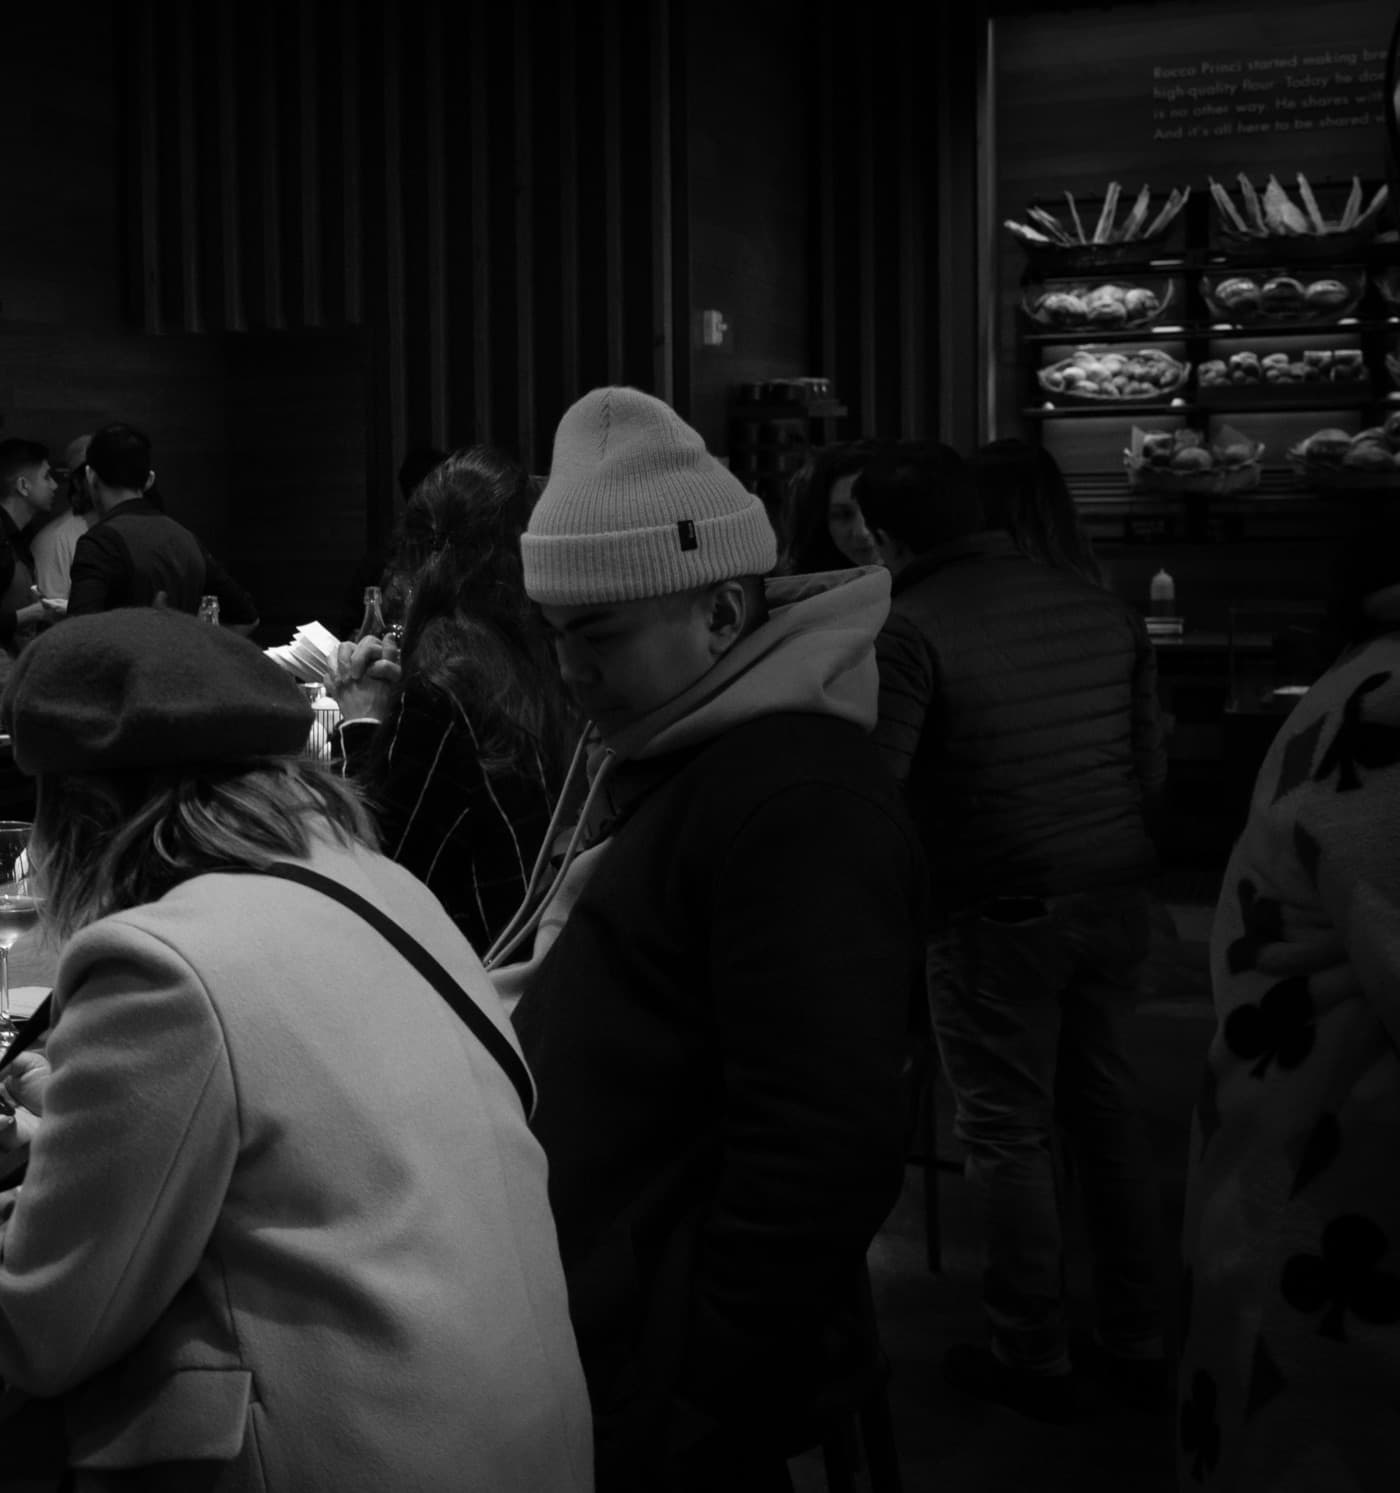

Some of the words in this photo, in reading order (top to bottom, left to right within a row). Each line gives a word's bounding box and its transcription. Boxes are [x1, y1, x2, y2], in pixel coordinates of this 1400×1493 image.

[1153, 66, 1197, 79] Rocco
[1201, 61, 1241, 73] Princi
[1248, 55, 1297, 71] started
[1303, 50, 1357, 65] making
[1362, 48, 1387, 62] bre
[1285, 74, 1329, 88] Today
[1335, 71, 1353, 83] he
[1358, 69, 1385, 83] doe
[1169, 107, 1188, 119] no
[1193, 103, 1229, 117] other
[1275, 95, 1296, 109] He
[1301, 93, 1349, 107] shares
[1153, 125, 1184, 140] And
[1213, 122, 1233, 136] all
[1237, 120, 1270, 134] here
[1274, 118, 1290, 131] to
[1294, 117, 1313, 129] be
[1319, 113, 1369, 128] shared
